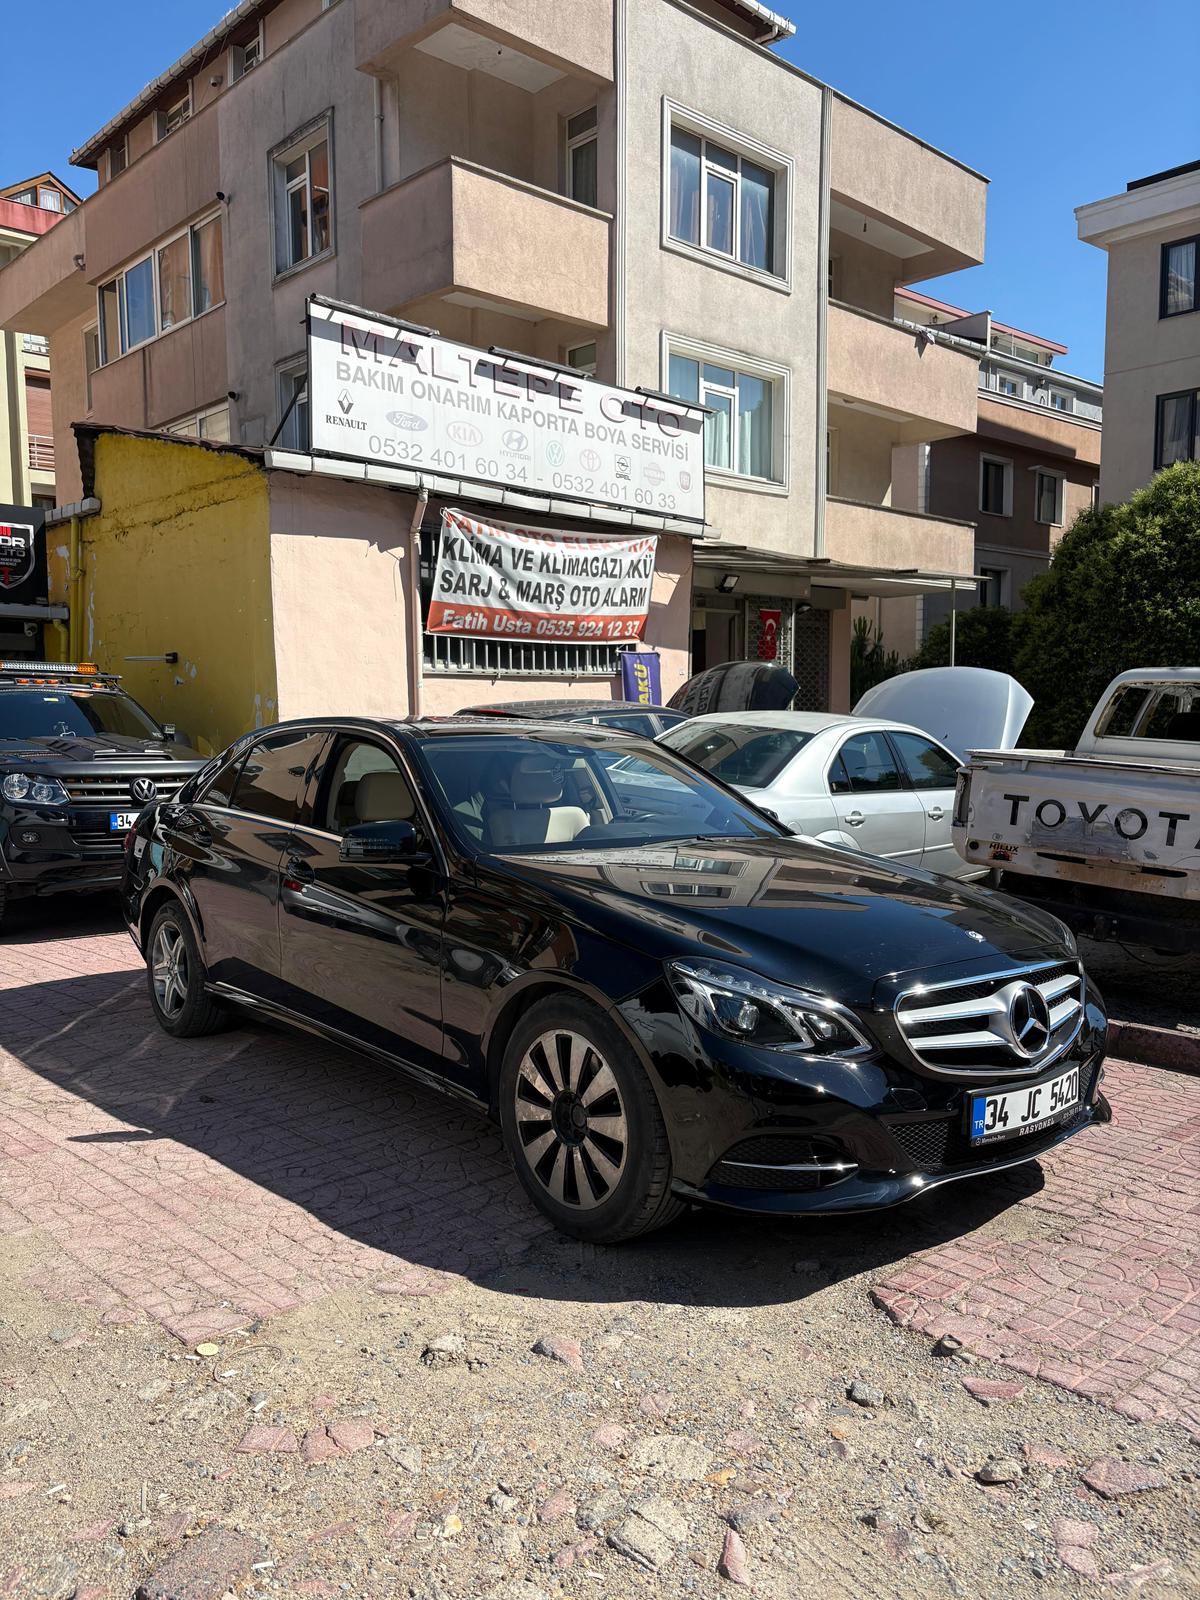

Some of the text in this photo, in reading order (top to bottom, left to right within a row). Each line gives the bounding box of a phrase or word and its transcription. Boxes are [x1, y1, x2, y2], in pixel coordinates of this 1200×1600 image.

[341, 319, 683, 438] MALTEPE OTO
[325, 414, 368, 431] RENAULT
[336, 360, 689, 461] BAKIM ONARIM KAPORTA BOYA SERVİSİ
[392, 413, 420, 429] Ford
[452, 424, 478, 443] KIA
[369, 435, 424, 462] 0532
[430, 448, 466, 471] 401
[475, 457, 499, 477] 60
[505, 463, 528, 482] 34
[552, 472, 595, 494] 0532
[600, 481, 628, 500] 401
[634, 489, 653, 504] 60
[658, 493, 676, 510] 33
[442, 535, 503, 568] KLİMA
[512, 547, 534, 571] VE
[623, 554, 653, 578] AKÜ
[440, 569, 647, 611] SARJ & MARŞ OTO ALARM
[442, 608, 640, 637] Fatih Usta 0535 924 12 37
[634, 662, 649, 705] AKÜ
[118, 814, 132, 827] 34
[1003, 793, 1200, 849] TOYOT
[989, 842, 1019, 852] HILUX
[974, 1120, 985, 1130] TR
[985, 1097, 1009, 1131] 34
[1021, 1088, 1042, 1122] JC
[1050, 1070, 1078, 1112] 5420
[1019, 1117, 1055, 1136] RASYONEL
